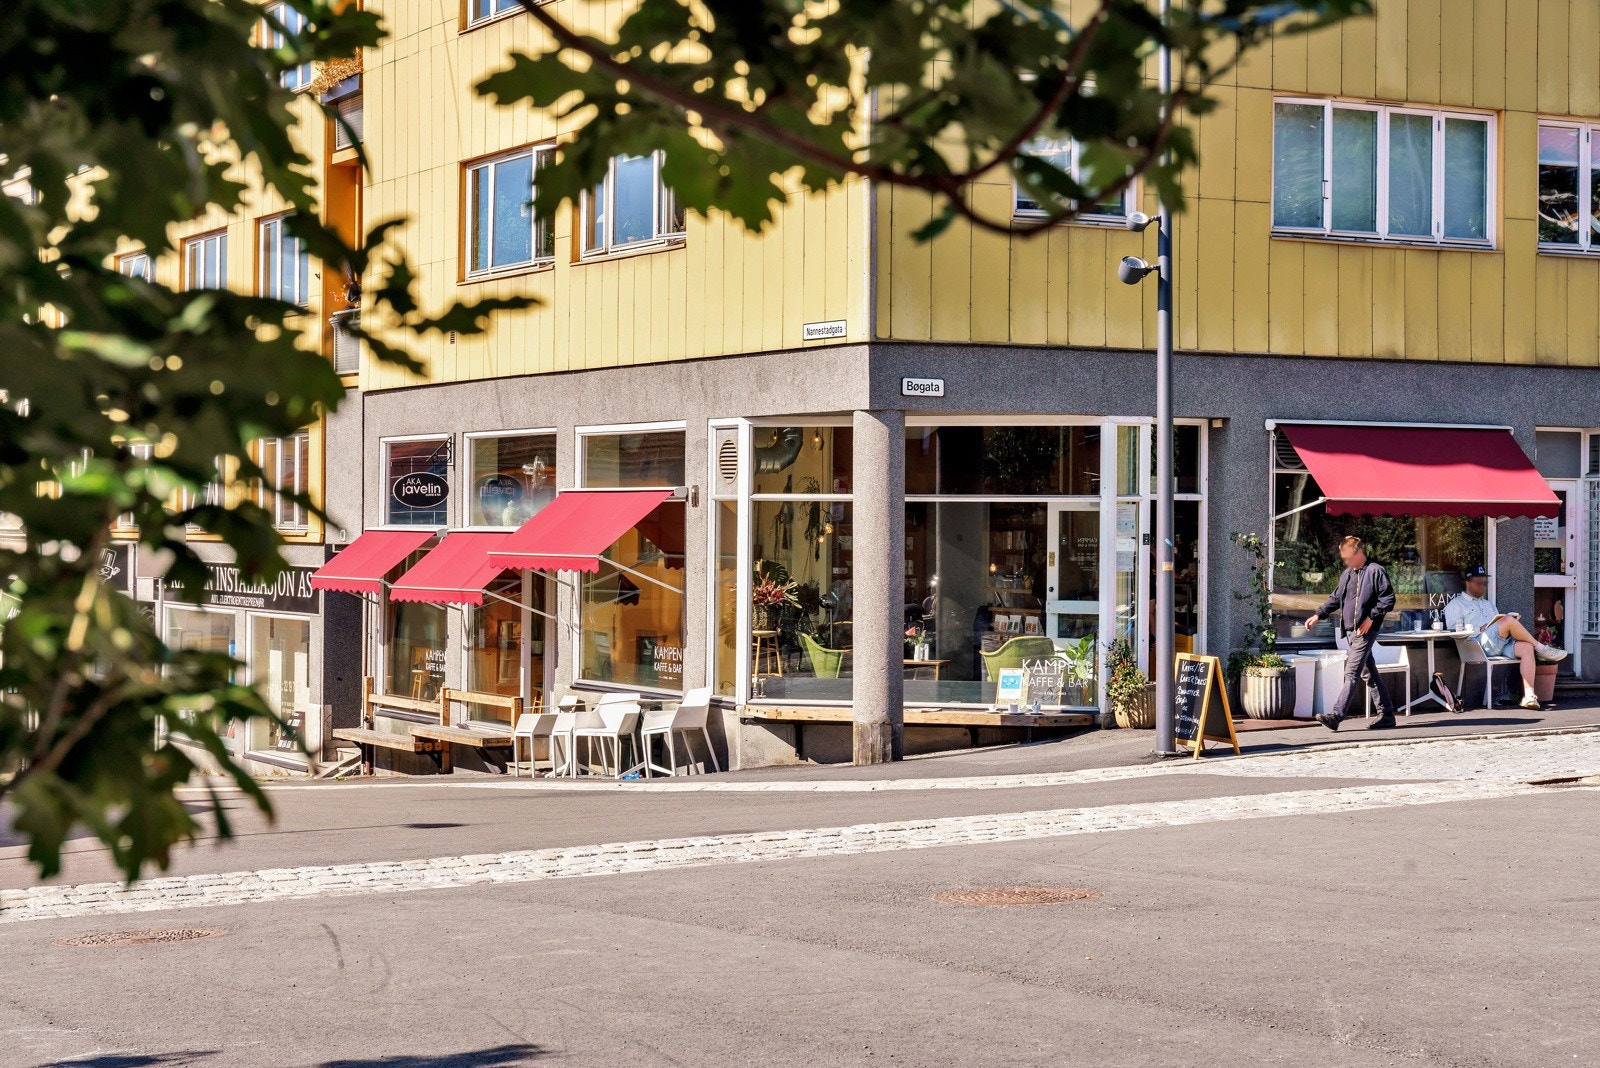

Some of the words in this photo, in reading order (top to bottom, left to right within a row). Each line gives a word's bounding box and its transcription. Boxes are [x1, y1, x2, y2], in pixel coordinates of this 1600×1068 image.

[806, 324, 843, 336] Nannestadgata
[906, 380, 940, 394] Bøgata
[402, 483, 441, 497] javelin
[297, 571, 313, 598] AS
[654, 645, 682, 661] KAMPEN
[654, 661, 668, 672] KAFFE
[673, 664, 682, 674] BAR
[1023, 677, 1053, 687] KAFFE
[1068, 678, 1088, 688] BAR
